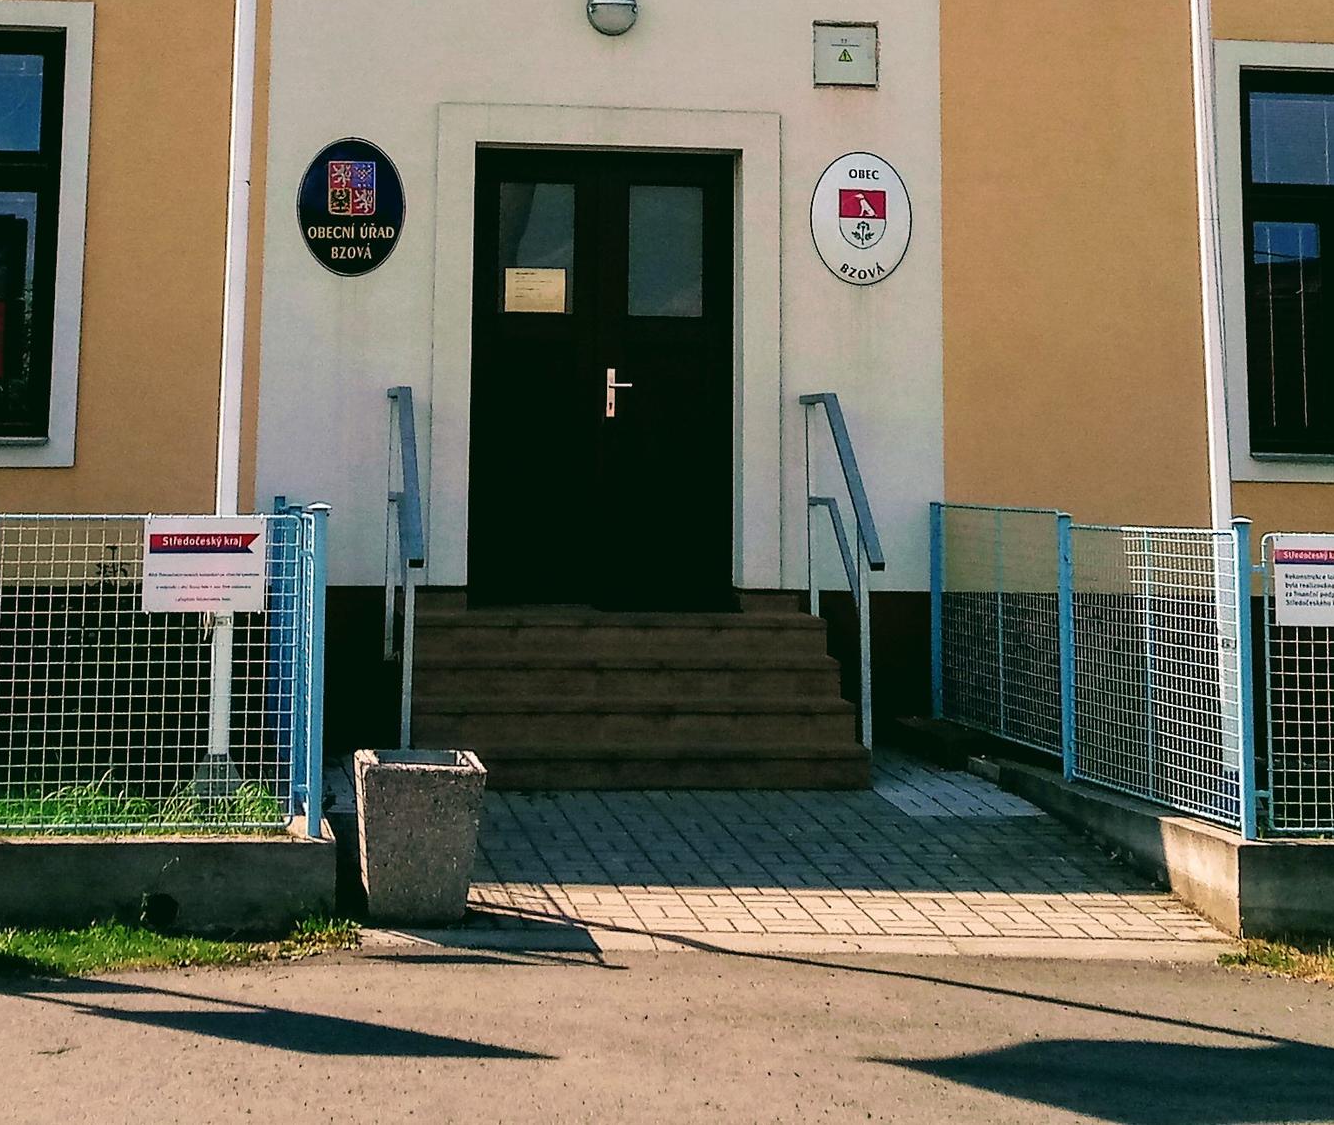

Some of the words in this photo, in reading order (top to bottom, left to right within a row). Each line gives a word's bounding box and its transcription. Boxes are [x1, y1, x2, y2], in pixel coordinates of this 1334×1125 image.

[848, 168, 880, 180] OBEC
[307, 223, 355, 239] OBECNÍ
[359, 222, 395, 239] ÚŘAD
[331, 243, 372, 260] BZOVÁ
[839, 261, 886, 280] BZOVÁ
[162, 536, 222, 548] Středočeský
[223, 536, 243, 548] kraj
[1283, 550, 1327, 561] Středočeský
